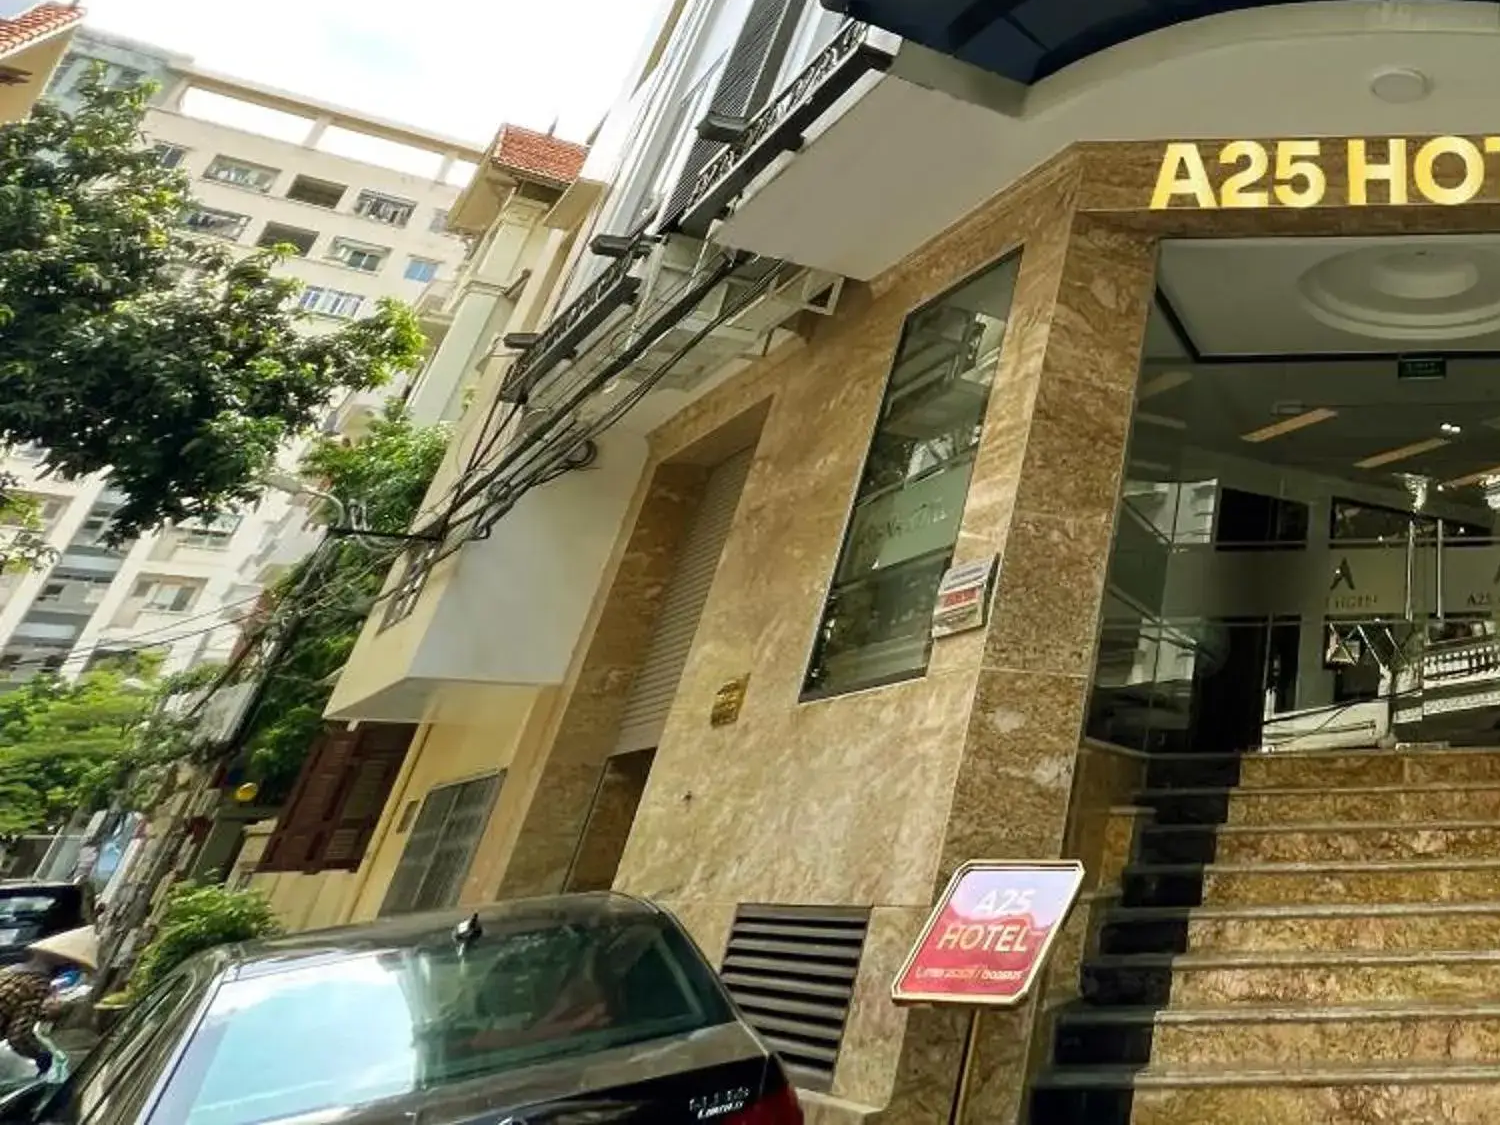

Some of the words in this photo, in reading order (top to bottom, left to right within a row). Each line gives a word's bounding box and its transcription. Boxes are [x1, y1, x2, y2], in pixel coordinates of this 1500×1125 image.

[1149, 139, 1327, 210] A25
[973, 889, 1035, 915] A25
[937, 923, 1029, 953] HOTEL
